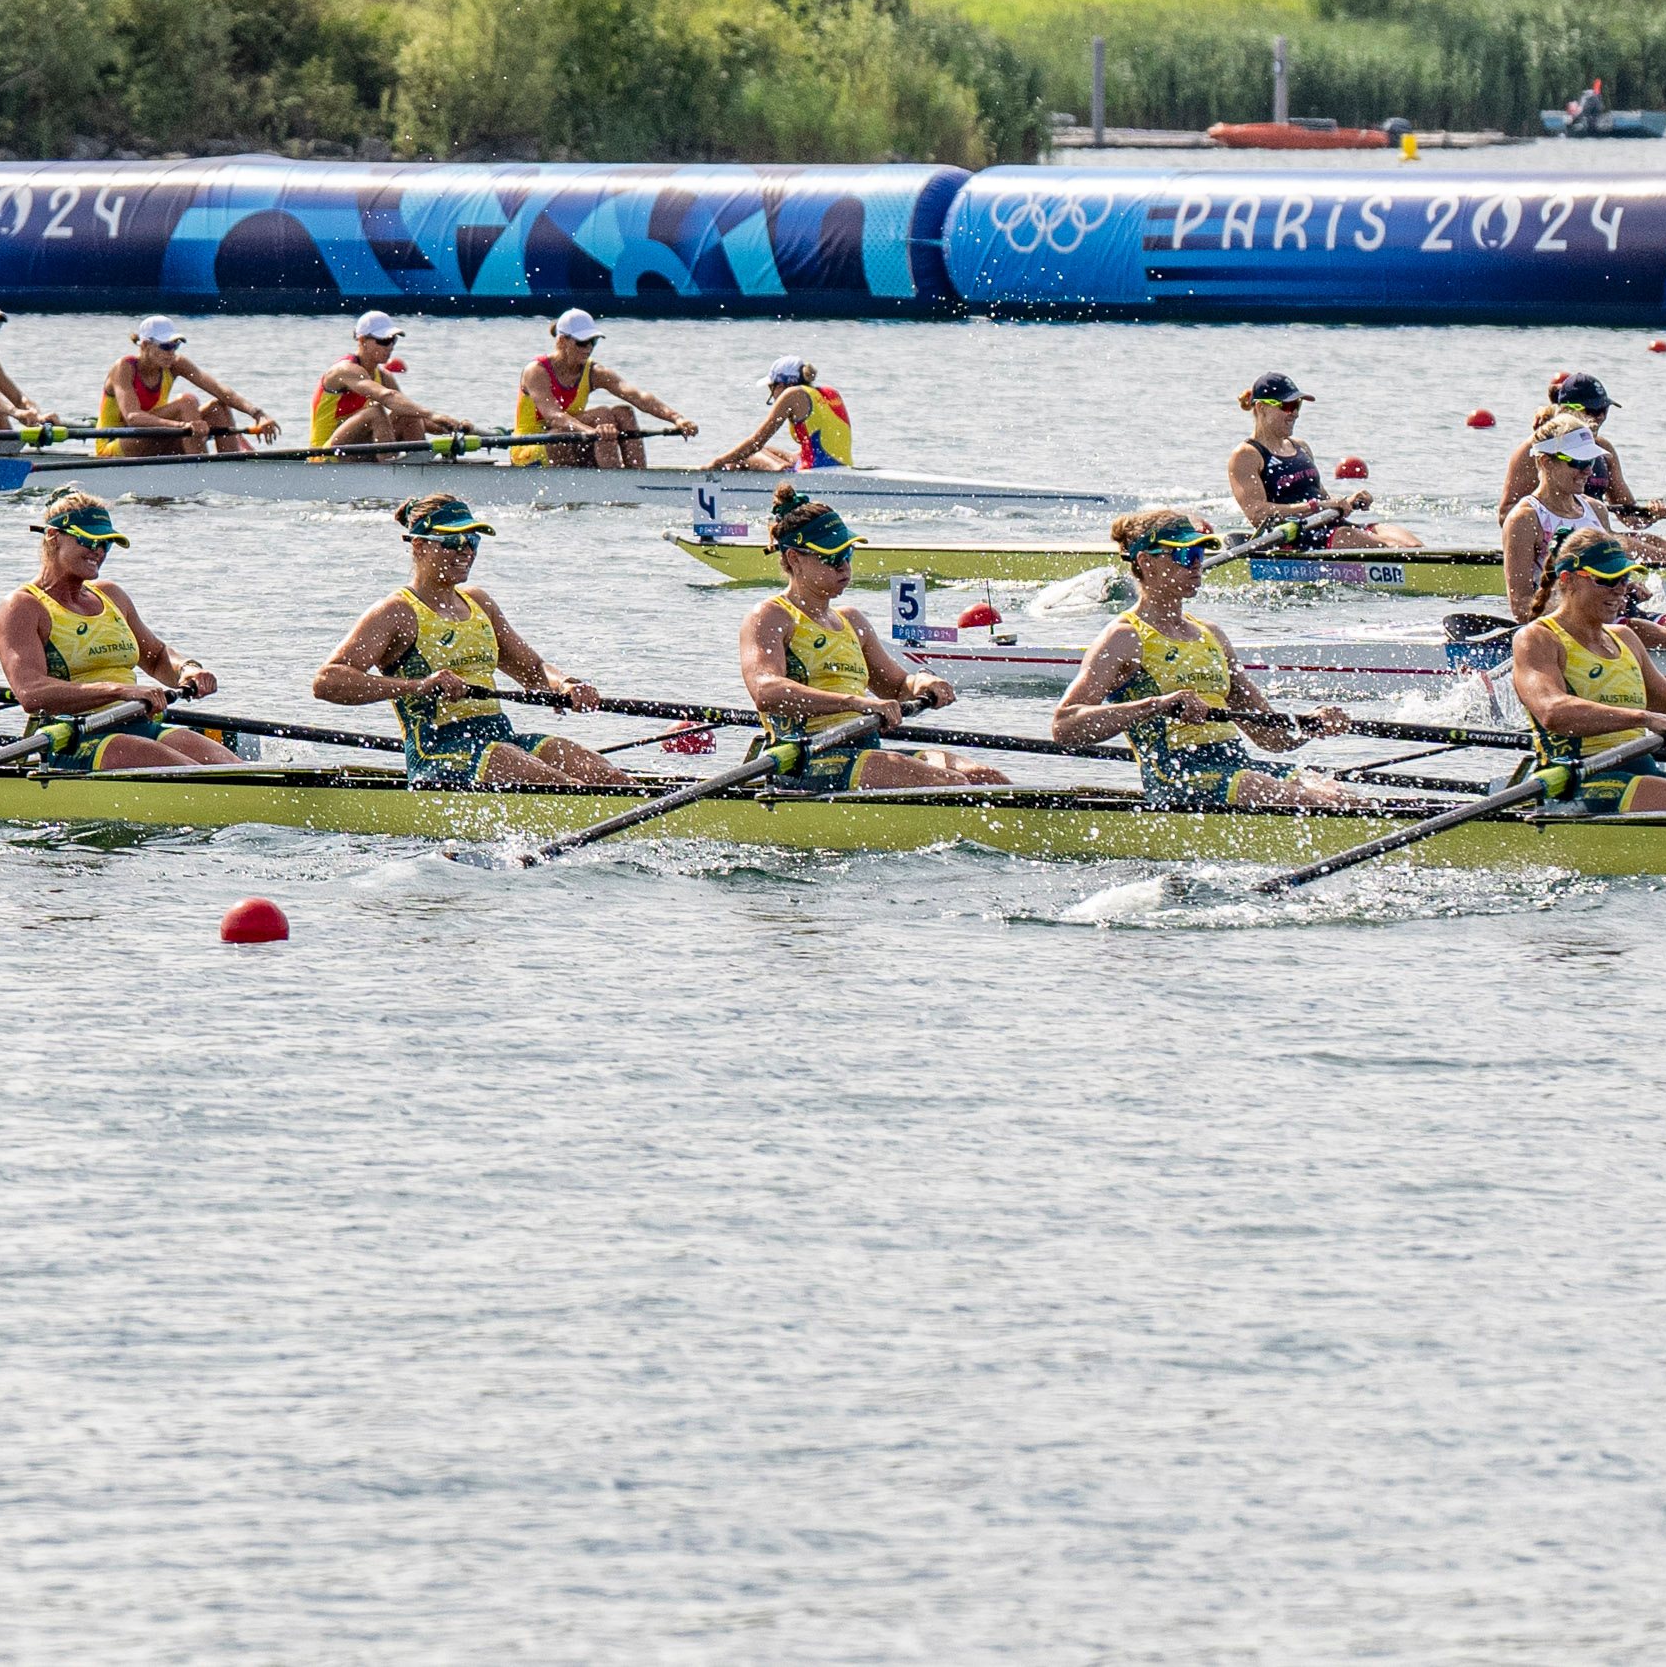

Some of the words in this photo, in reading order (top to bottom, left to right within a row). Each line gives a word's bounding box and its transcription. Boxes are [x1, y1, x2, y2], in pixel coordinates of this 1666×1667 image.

[1421, 194, 1625, 253] 2024
[698, 488, 716, 520] 4
[1369, 566, 1403, 583] GBR
[898, 583, 919, 621] 5
[88, 641, 136, 656] AUSTRALIA
